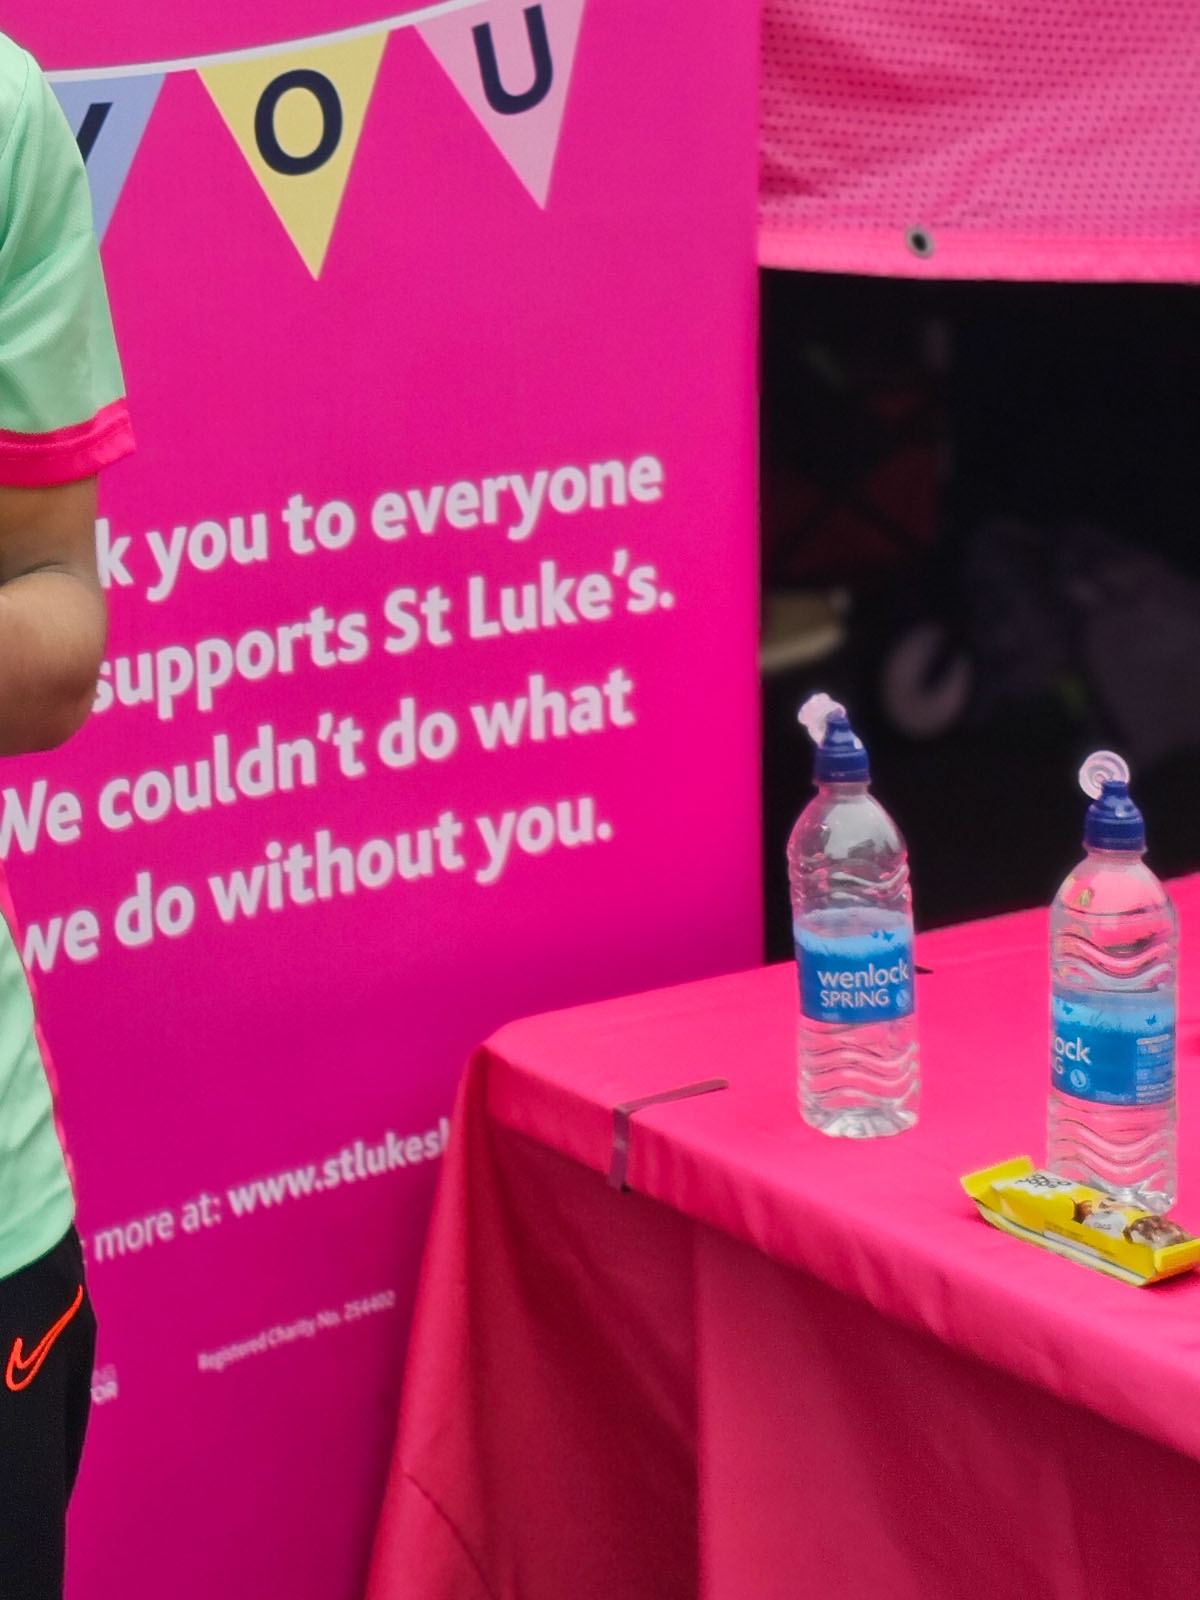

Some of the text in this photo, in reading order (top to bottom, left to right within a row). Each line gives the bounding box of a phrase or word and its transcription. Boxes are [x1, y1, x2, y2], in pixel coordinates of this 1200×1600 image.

[146, 512, 267, 602] you
[282, 494, 355, 554] to
[372, 455, 663, 540] everyone
[91, 549, 675, 721] supports St Luke's.
[99, 713, 365, 830] couldn't
[379, 698, 457, 767] do
[471, 669, 634, 749] what
[23, 797, 612, 973] we do without you.
[817, 957, 910, 988] wenlock
[820, 988, 891, 1009] SPRING
[95, 1216, 174, 1262] more
[182, 1194, 220, 1232] at:
